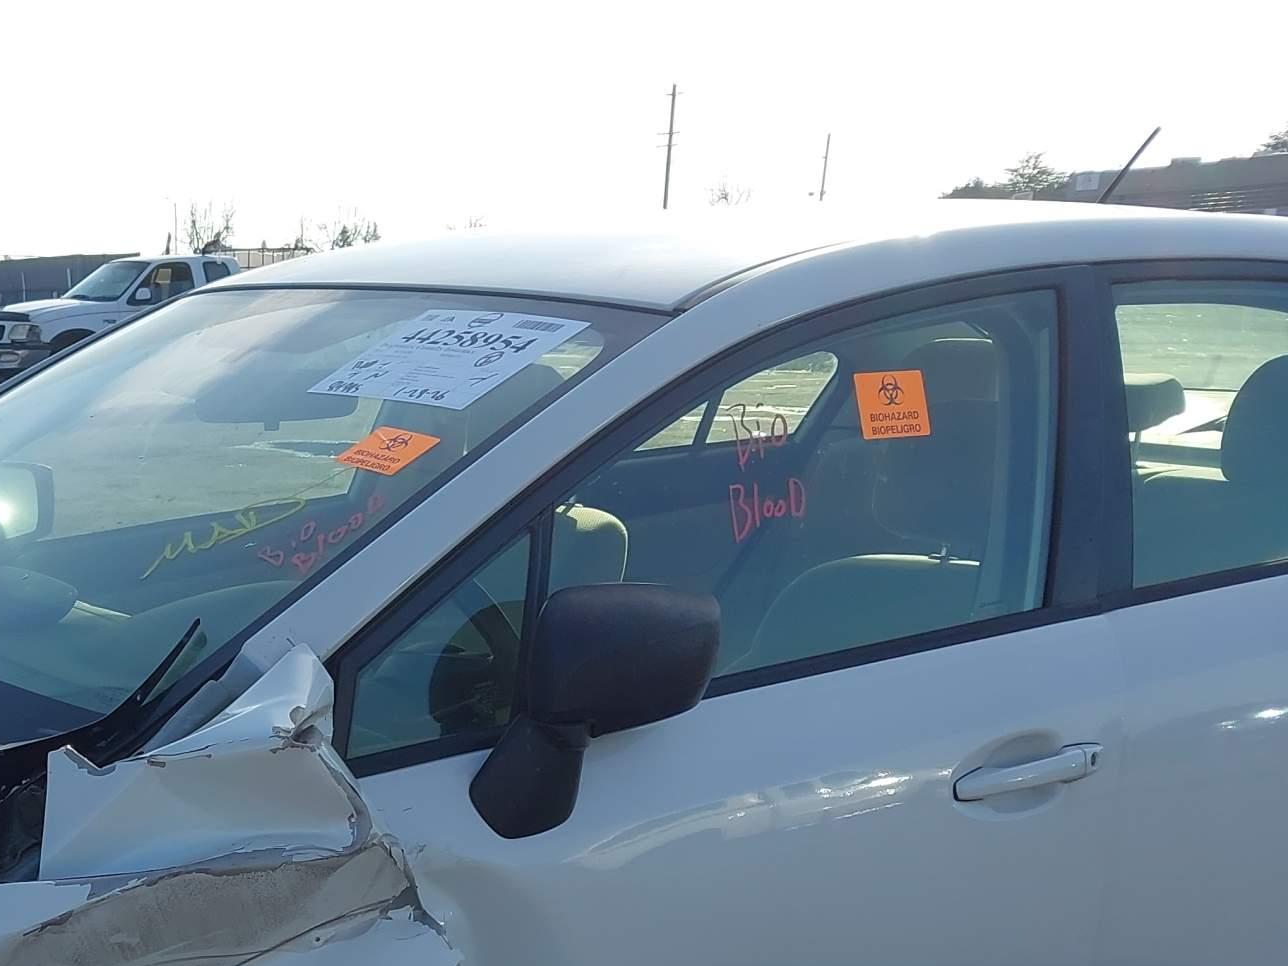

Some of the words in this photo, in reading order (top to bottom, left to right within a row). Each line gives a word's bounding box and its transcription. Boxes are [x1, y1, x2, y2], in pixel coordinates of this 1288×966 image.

[401, 327, 538, 354] 44258954
[869, 410, 920, 423] BIOHAZARD
[871, 423, 922, 436] BIOPELIGRO
[353, 449, 401, 464] BIOHAZARD
